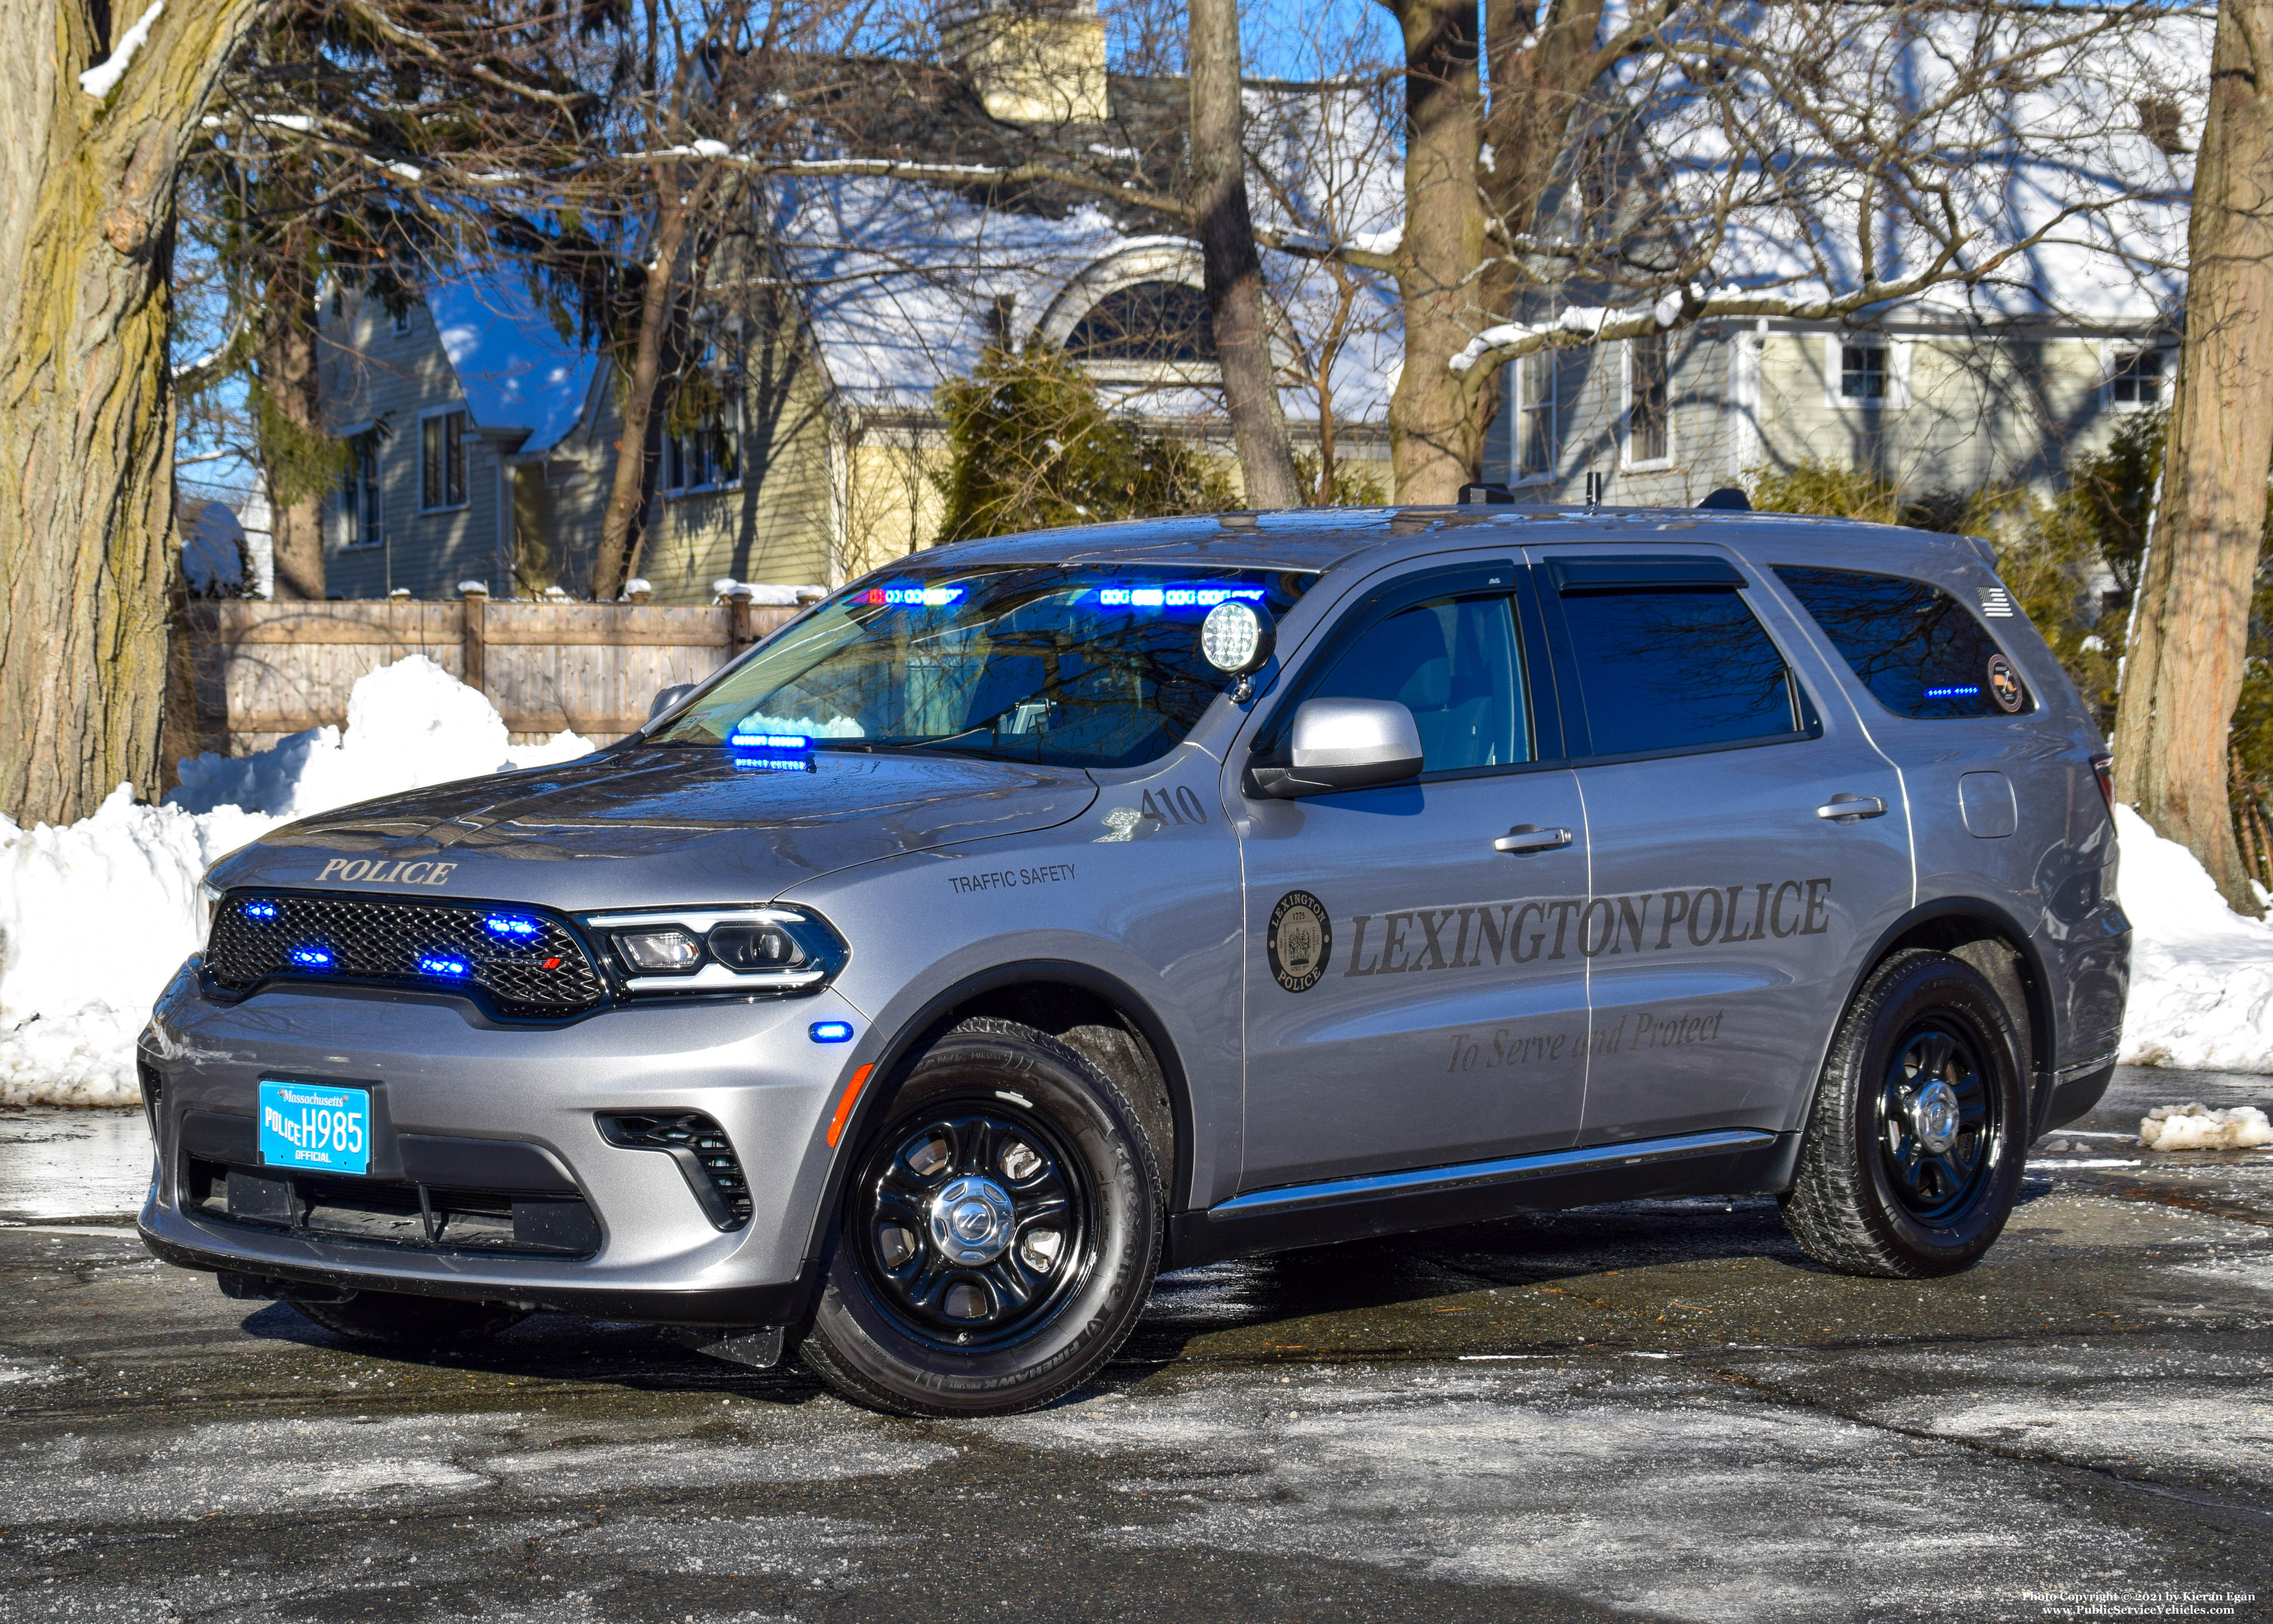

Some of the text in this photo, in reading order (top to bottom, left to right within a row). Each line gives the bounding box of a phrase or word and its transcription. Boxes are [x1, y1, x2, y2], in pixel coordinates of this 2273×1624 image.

[1141, 785, 1206, 826] 410
[315, 859, 458, 886] POLICE
[948, 864, 1075, 893] TRAFFIC SAFETY
[1272, 894, 1326, 928] LEXINGTON
[1293, 912, 1305, 920] 1775
[1343, 877, 1832, 978] LEXINGTON POLICE
[484, 957, 550, 966] DODGE
[1278, 967, 1321, 990] POLICE
[1446, 1009, 1723, 1073] To Serve and Protect
[283, 1089, 343, 1108] Massachusetts
[265, 1106, 362, 1153] POLICE H985
[295, 1150, 331, 1163] OFFICIAL
